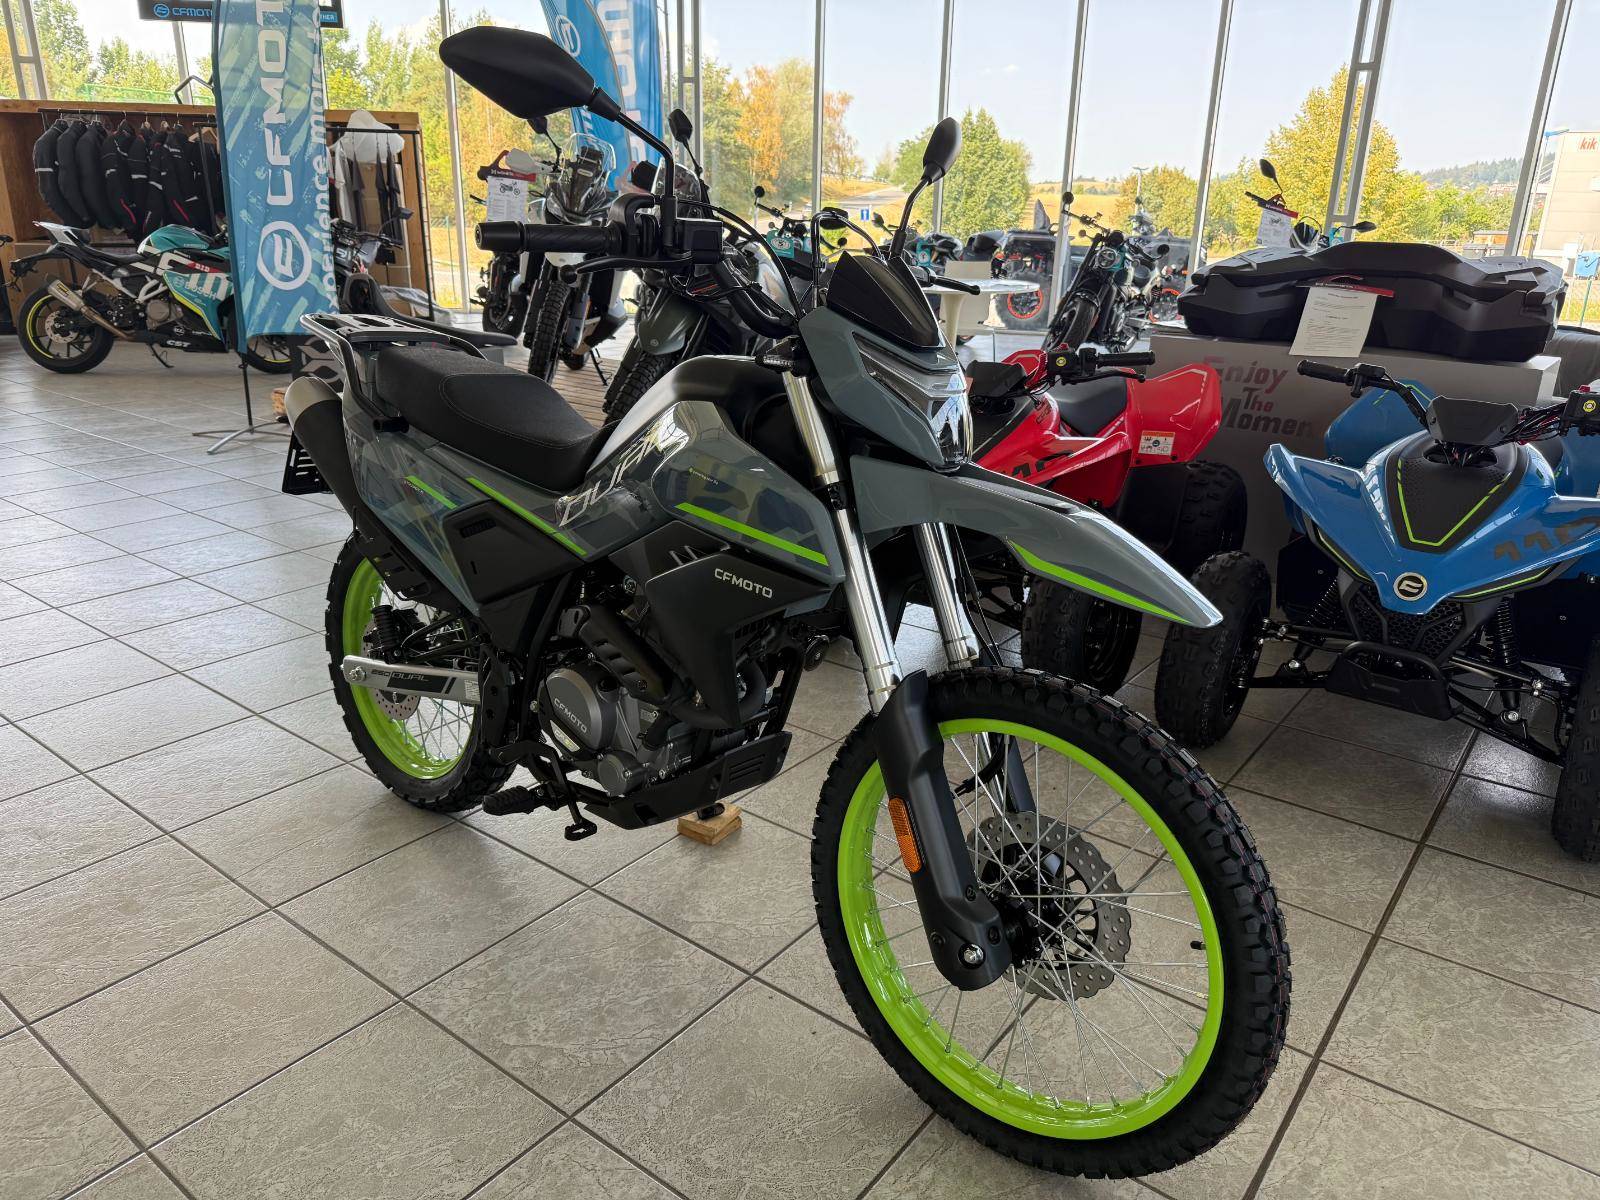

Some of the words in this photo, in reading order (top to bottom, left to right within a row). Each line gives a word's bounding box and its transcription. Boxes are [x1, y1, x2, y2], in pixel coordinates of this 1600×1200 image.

[172, 7, 213, 17] CFMOT
[1580, 136, 1598, 150] kik
[313, 154, 340, 315] xperience
[1242, 386, 1275, 413] The
[714, 567, 773, 599] CFMOTO
[554, 697, 588, 734] CFMOTO
